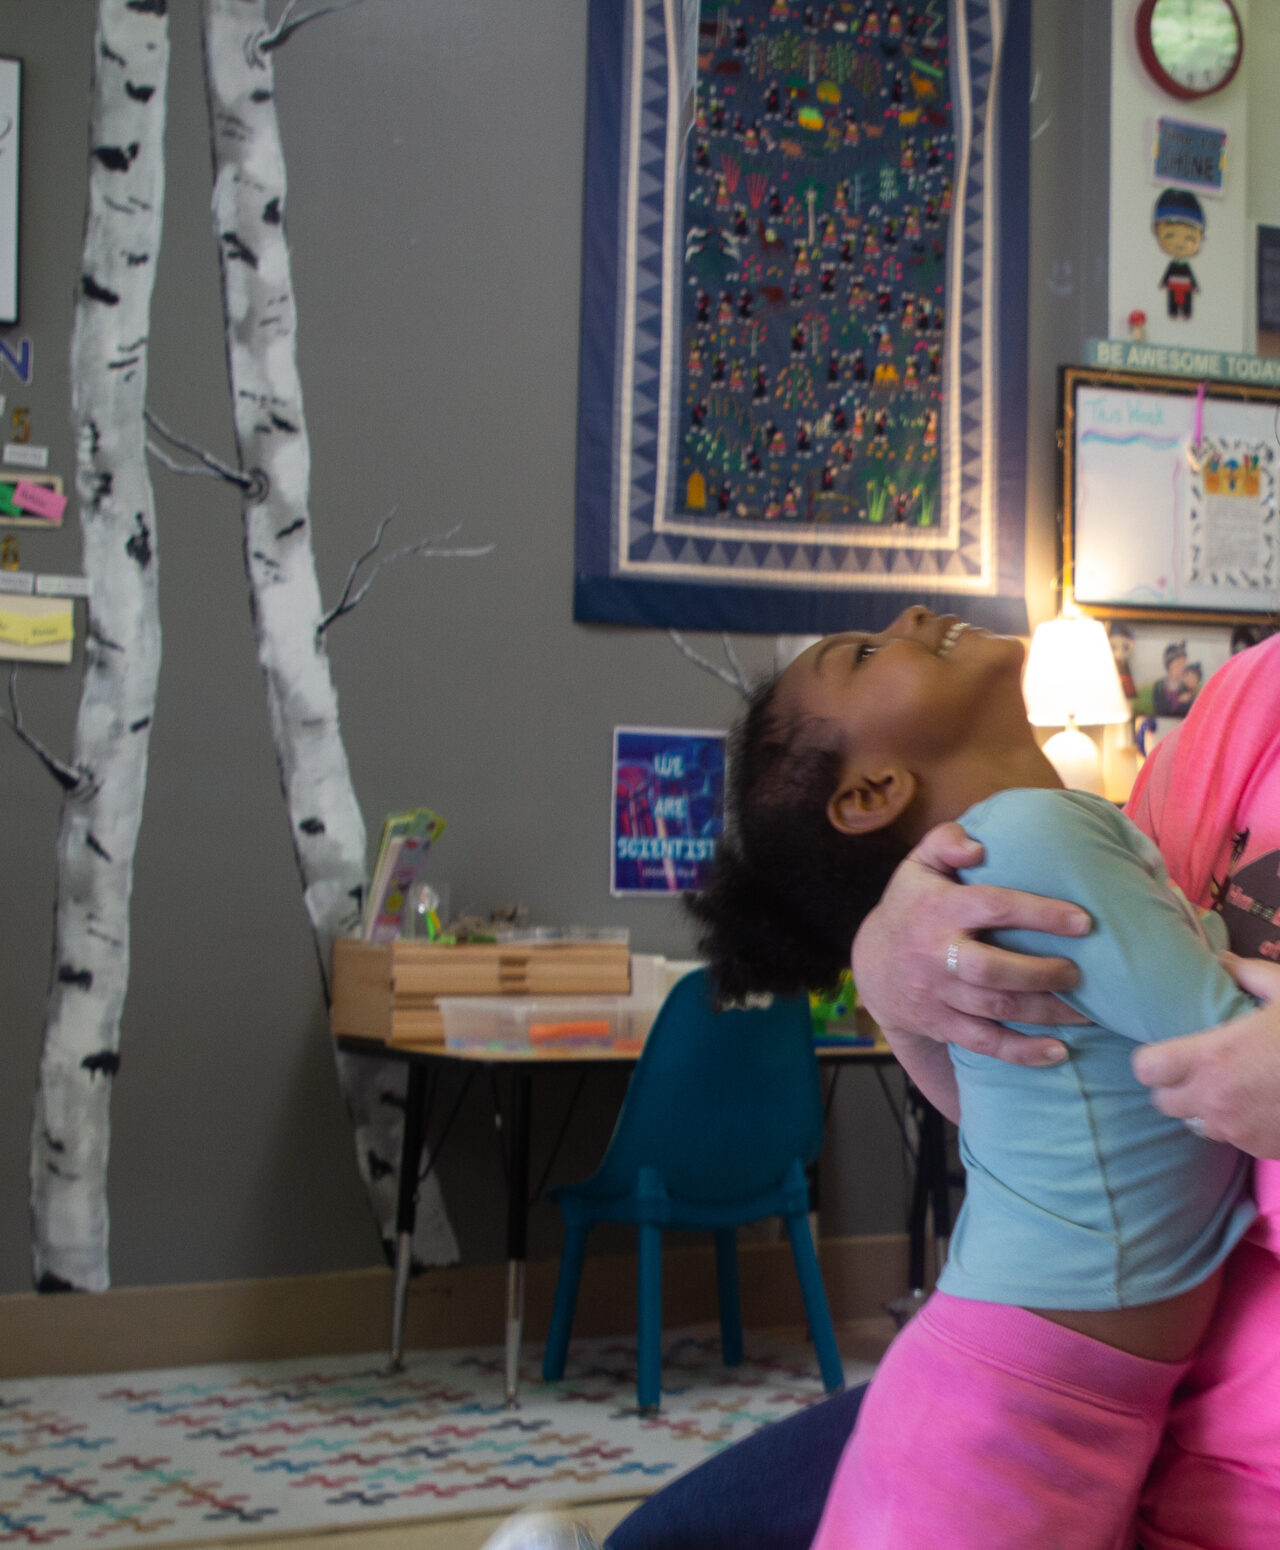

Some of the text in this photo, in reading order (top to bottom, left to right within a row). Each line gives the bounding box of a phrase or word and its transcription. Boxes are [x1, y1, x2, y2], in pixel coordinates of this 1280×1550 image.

[1097, 343, 1123, 365] BE
[1127, 346, 1222, 376] AWESOME
[653, 754, 685, 778] WE
[653, 796, 688, 820] ARE
